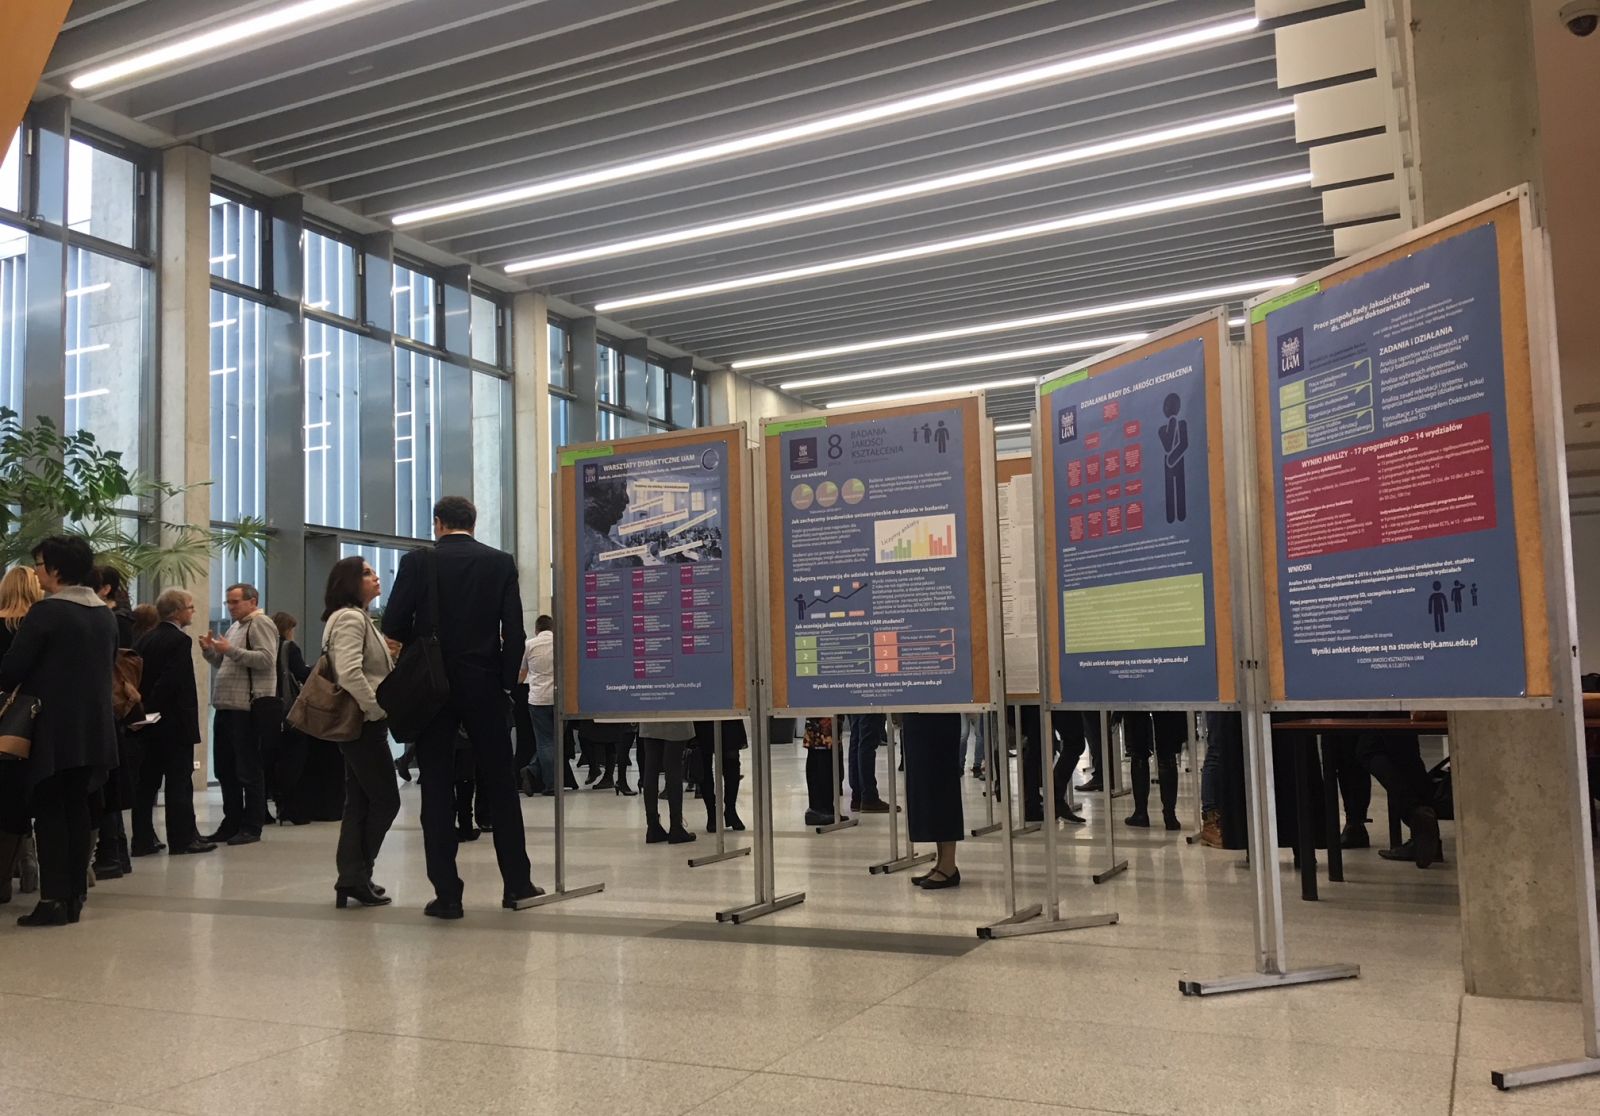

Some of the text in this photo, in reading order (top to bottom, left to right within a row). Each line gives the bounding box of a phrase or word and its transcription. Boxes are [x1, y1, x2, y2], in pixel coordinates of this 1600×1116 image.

[1314, 283, 1430, 330] Prace zespołu Rady Jakości Kształcenia
[1340, 316, 1364, 328] studiów
[1366, 298, 1410, 319] doktoranckich
[1380, 340, 1409, 355] ZADANIA
[1414, 326, 1452, 344] DZIAŁANIA
[1282, 354, 1299, 371] UAM
[1380, 359, 1397, 368] Analiza
[1398, 352, 1421, 362] raportów
[1422, 339, 1457, 355] wydziałowych
[1395, 360, 1414, 369] badania
[1416, 354, 1432, 364] jakości
[1433, 345, 1461, 357] kształcenia
[1381, 360, 1455, 386] Analiza wybranych elementów
[1381, 362, 1468, 392] programów studiów doktoranckich
[1081, 366, 1192, 408] DZIAŁANIA RADY DS. JAKOŚCI KSZTAŁCENIA
[1382, 401, 1403, 410] wsparcia
[1404, 392, 1436, 404] materialnego
[1437, 384, 1462, 395] (działanie
[1470, 378, 1484, 386] toku)
[1400, 390, 1414, 399] zasad
[1415, 384, 1438, 395] rekrutacji
[1442, 378, 1463, 389] systemu
[1382, 412, 1410, 423] Konsultacje
[1415, 402, 1448, 414] Samorządem
[1448, 392, 1484, 405] Doktorantów
[851, 428, 886, 439] BADANIA
[1386, 416, 1418, 427] Kierownikami
[828, 434, 842, 459] 8
[851, 446, 903, 458] KSZTAŁCENIA
[852, 438, 883, 449] JAKOŚCI
[1302, 457, 1322, 468] WYNIKI
[1323, 451, 1348, 462] ANALIZY
[1363, 439, 1398, 454] programów
[1400, 436, 1409, 444] SD
[1425, 424, 1462, 437] wydziałów
[604, 461, 636, 471] WARSZTATY
[638, 456, 680, 467] DYDAKTYCZNE
[1288, 564, 1312, 573] WNIOSKI
[1416, 562, 1443, 570] problemów
[1435, 567, 1461, 575] wydziałach
[1312, 647, 1331, 656] Wyniki
[1423, 638, 1477, 649] brjk.amu.edu.pl
